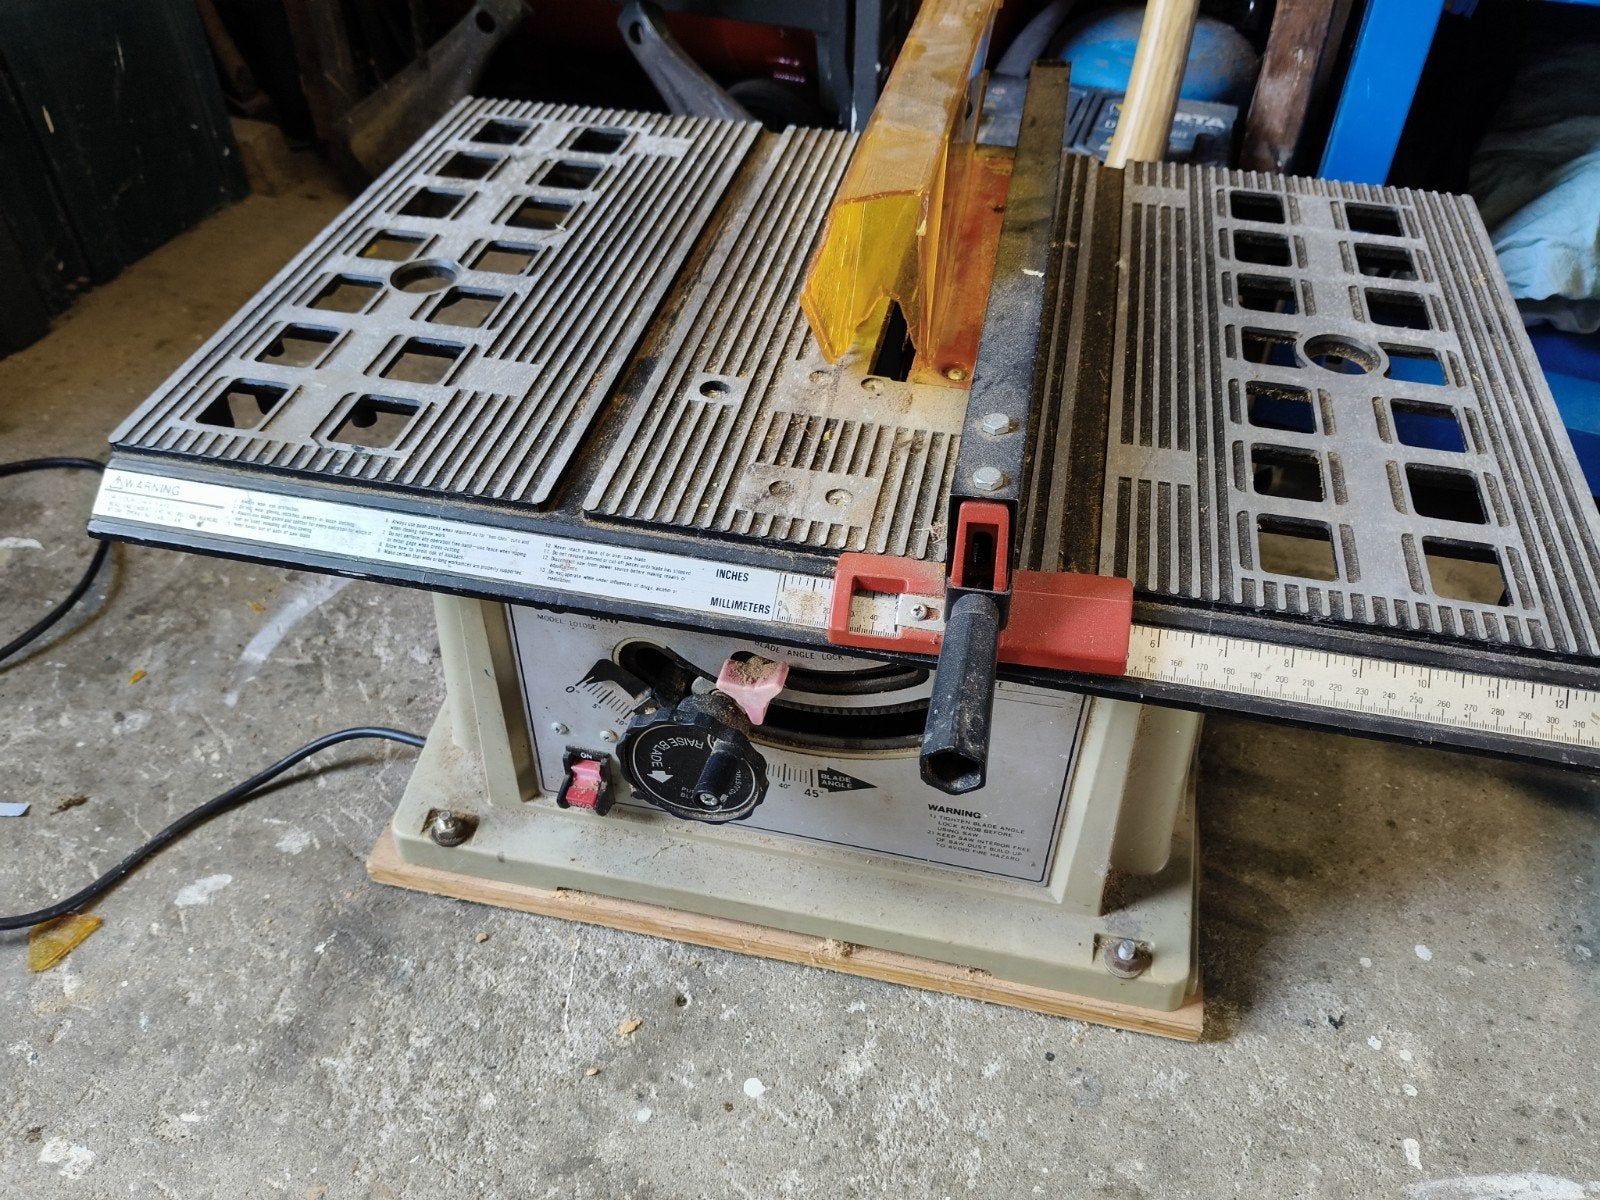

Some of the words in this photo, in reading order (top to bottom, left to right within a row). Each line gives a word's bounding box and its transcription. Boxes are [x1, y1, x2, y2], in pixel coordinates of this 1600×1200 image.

[125, 479, 180, 496] WARNING
[715, 568, 750, 583] INCHES
[709, 596, 772, 615] MILLIMETERS
[822, 606, 830, 615] 20
[536, 613, 564, 625] MODEL
[869, 614, 878, 622] 40
[1149, 639, 1156, 649] 6
[754, 640, 780, 654] BLADE
[786, 650, 815, 660] ANGLE
[821, 653, 844, 661] LOCK
[1218, 649, 1224, 657] 7
[1144, 655, 1157, 664] 150
[1170, 659, 1183, 668] 160
[1284, 658, 1290, 668] 8
[1196, 663, 1209, 671] 170
[1223, 667, 1236, 676] 180
[1249, 671, 1262, 680] 190
[1351, 668, 1358, 678] 9
[1275, 675, 1289, 684] 200
[1302, 679, 1315, 688] 210
[1417, 679, 1428, 689] 10
[1328, 683, 1342, 692] 220
[1355, 687, 1369, 696] 230
[1382, 691, 1396, 700] 240
[1486, 690, 1496, 699] 11
[1409, 695, 1424, 704] 250
[1436, 699, 1451, 708] 260
[1463, 703, 1478, 712] 270
[1554, 700, 1565, 709] 12
[1490, 708, 1505, 717] 280
[1517, 711, 1532, 720] 290
[1545, 715, 1560, 725] 300
[1572, 720, 1587, 729] 310
[667, 736, 704, 750] RAISE
[580, 752, 593, 760] ON
[650, 740, 671, 768] BLADE
[820, 773, 852, 783] BLADE
[821, 779, 854, 789] ANGLE
[927, 803, 982, 819] WARNING
[938, 821, 958, 829] LOCK
[960, 825, 982, 833] KNOB
[983, 828, 1013, 838] BEFORE
[939, 815, 971, 825] TIGHTEN
[972, 821, 998, 830] BLADE
[999, 826, 1025, 835] ANGLE
[937, 826, 960, 835] USING
[958, 835, 975, 843] SAW
[976, 839, 1011, 849] INTERIOR
[1012, 845, 1031, 853] FREE
[990, 853, 1021, 862] HAZARD
